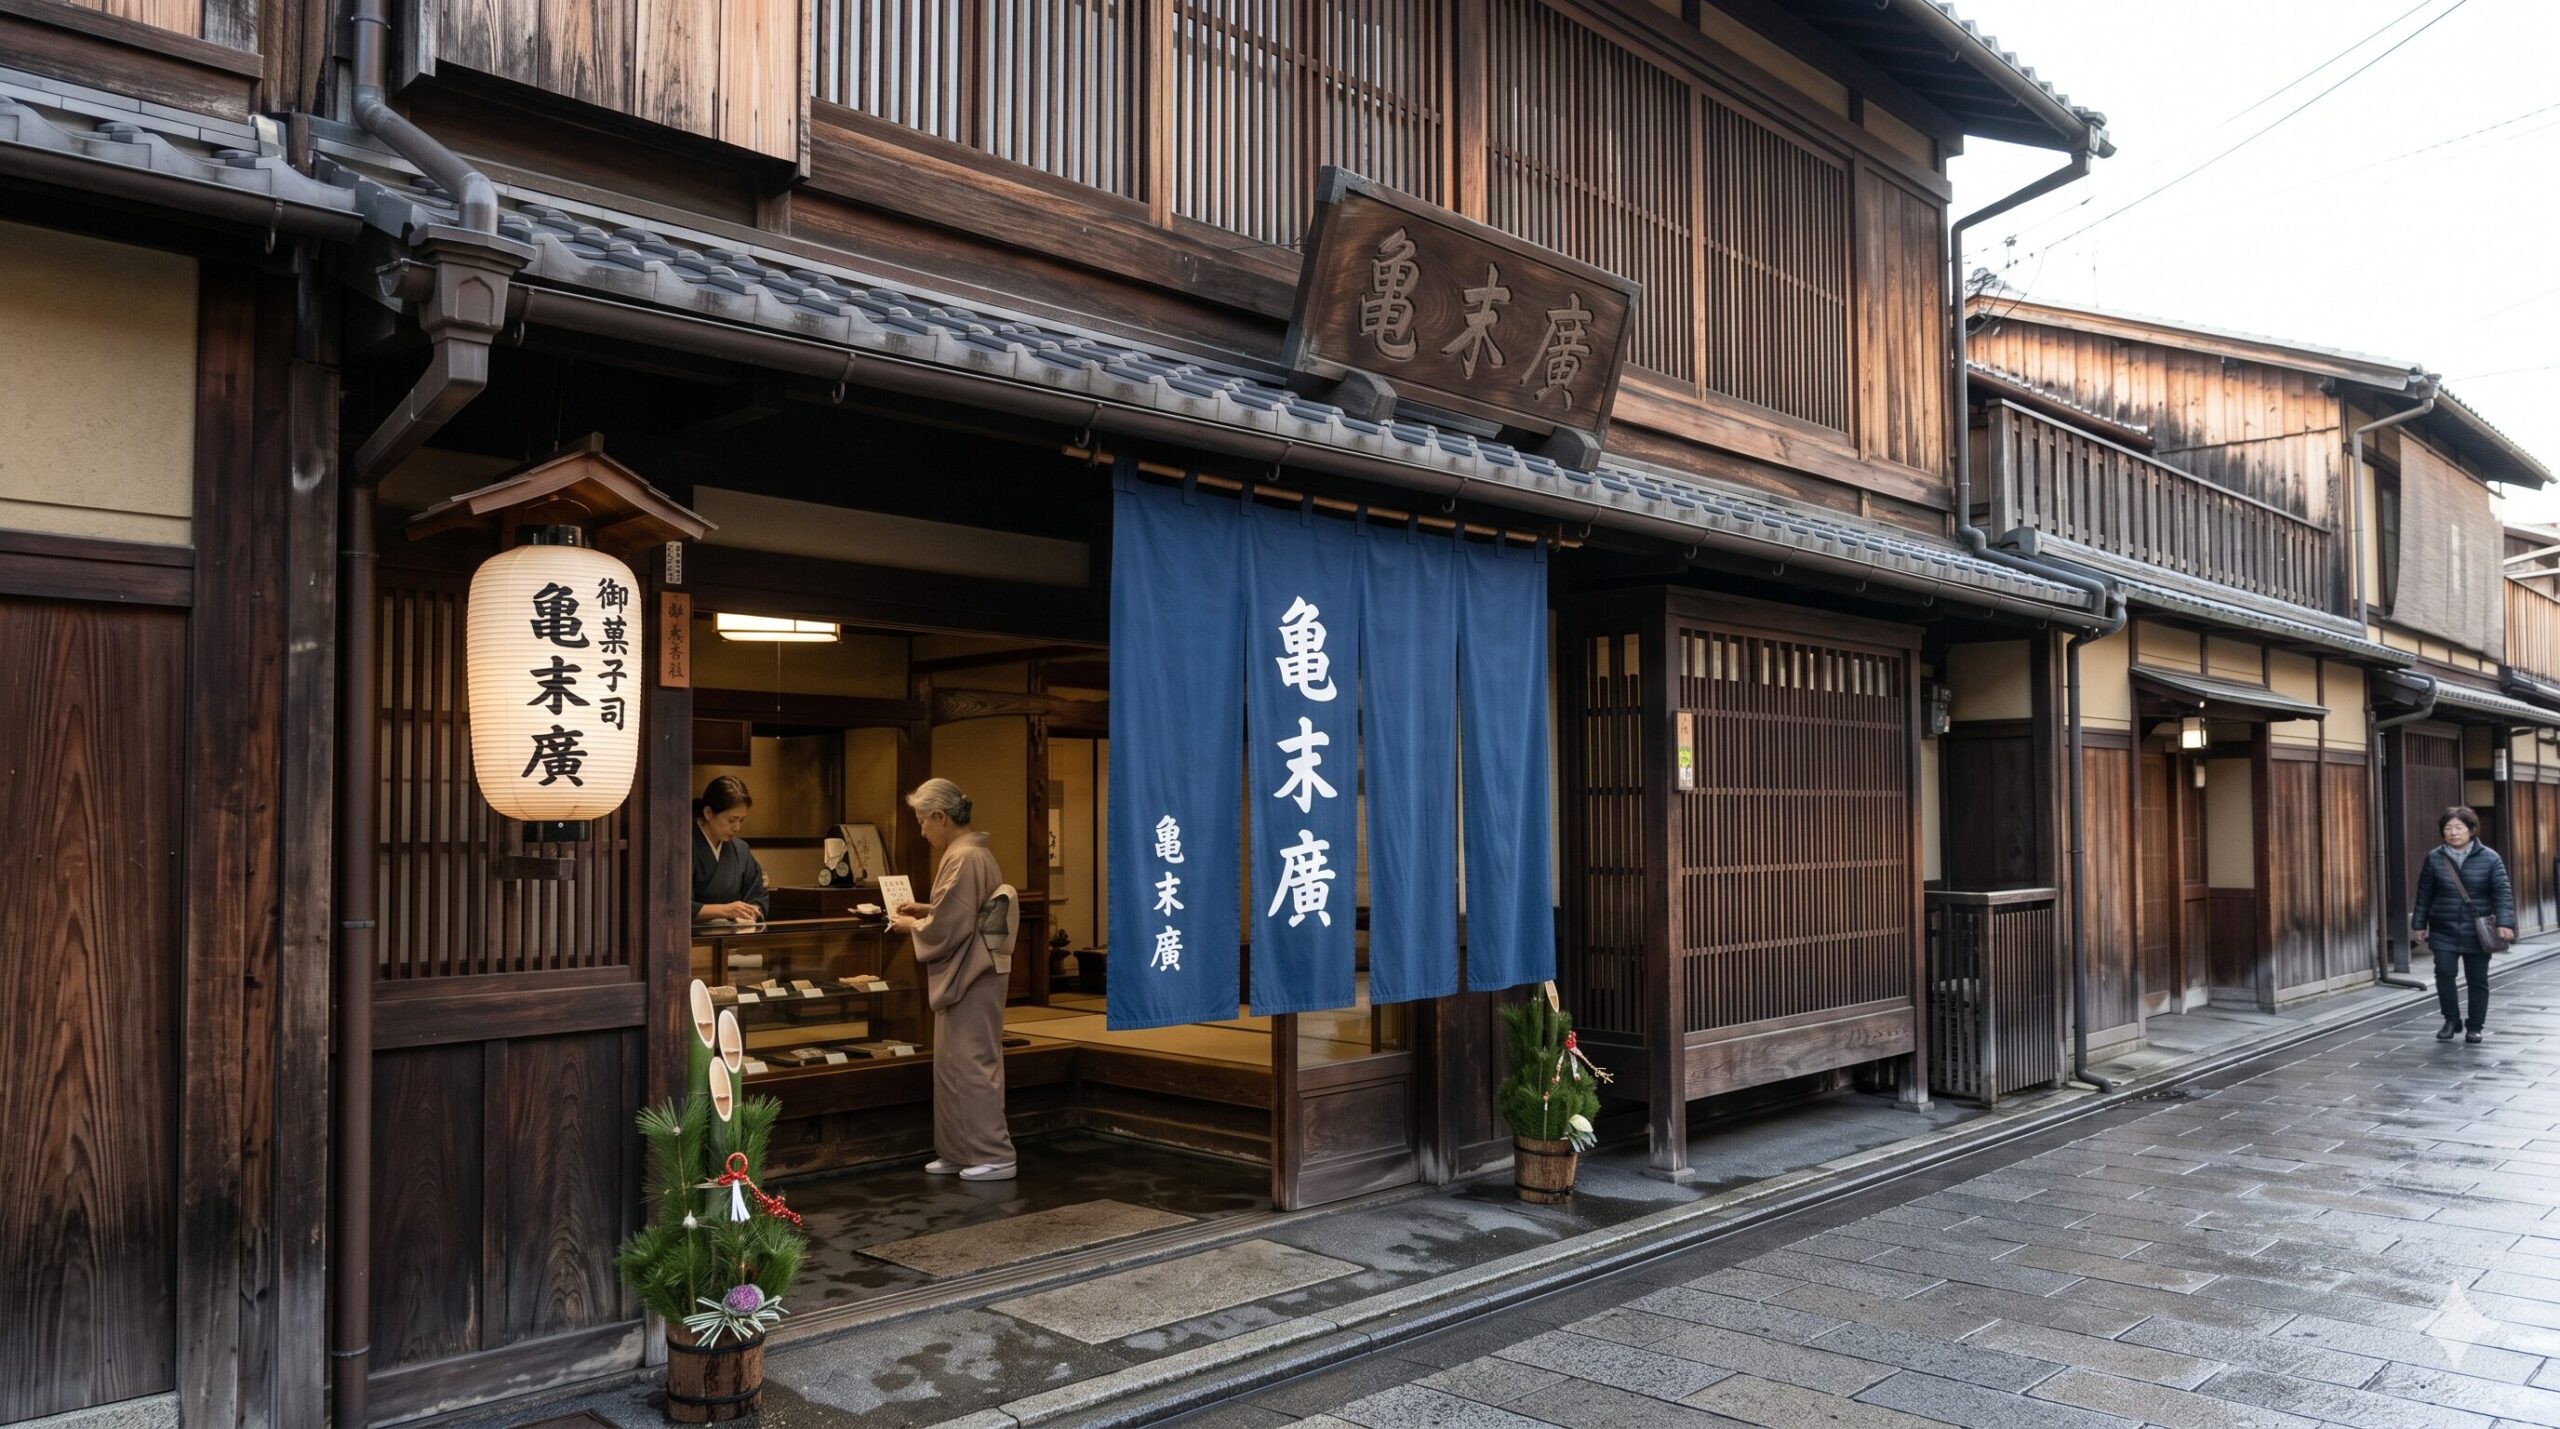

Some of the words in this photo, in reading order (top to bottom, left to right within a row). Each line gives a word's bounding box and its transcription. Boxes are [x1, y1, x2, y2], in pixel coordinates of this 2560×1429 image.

[1358, 226, 1594, 412] 亀末廣
[521, 582, 591, 787] 亀末廣
[596, 577, 629, 731] 御菓子司
[1268, 596, 1338, 928] 亀末廣
[1150, 814, 1185, 972] 亀末廣
